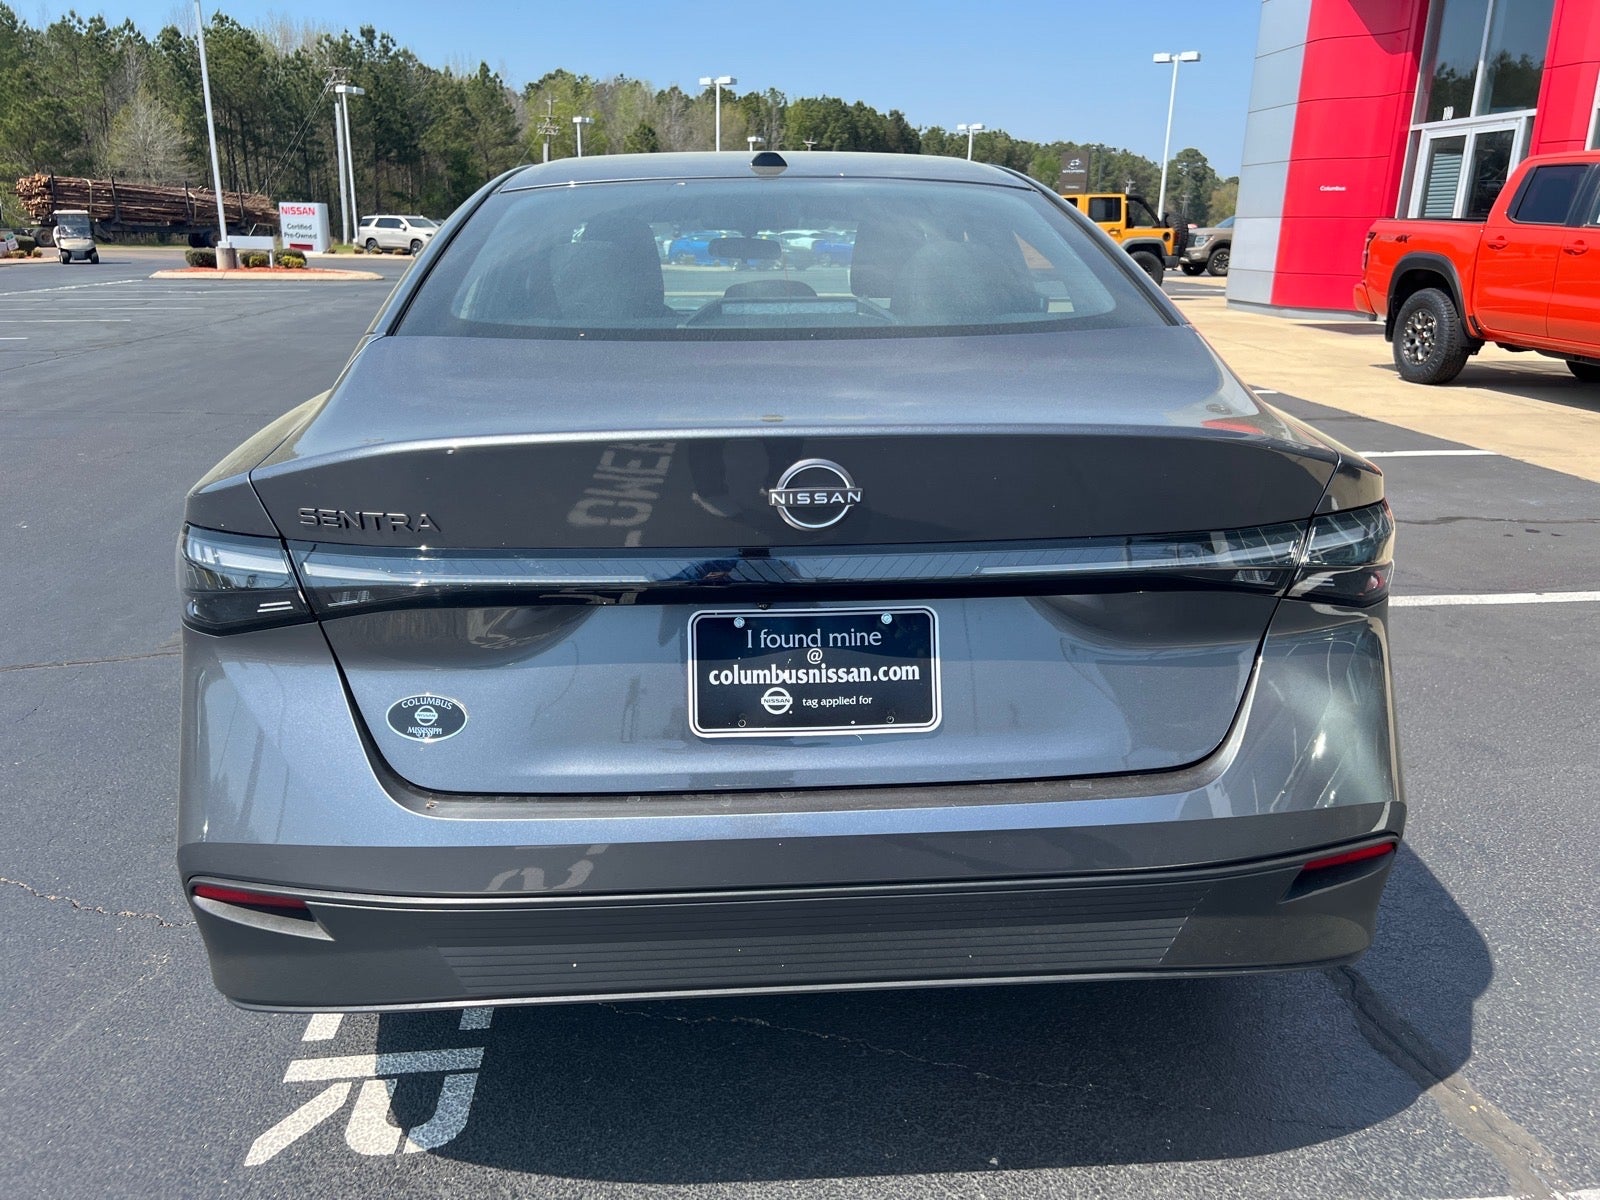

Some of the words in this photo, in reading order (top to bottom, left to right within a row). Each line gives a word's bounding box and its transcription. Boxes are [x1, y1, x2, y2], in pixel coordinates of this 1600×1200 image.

[281, 206, 315, 215] NISSAN
[287, 223, 312, 231] Certified
[771, 491, 861, 505] NISSAN
[298, 507, 441, 533] SENTRA
[746, 629, 753, 649] I
[760, 628, 822, 649] found
[828, 628, 882, 647] mine
[806, 648, 823, 664] @
[708, 663, 920, 686] columbusnissan.com
[401, 697, 453, 710] COLUMBUS
[802, 698, 819, 709] tag
[820, 696, 857, 708] applied
[859, 695, 873, 705] for
